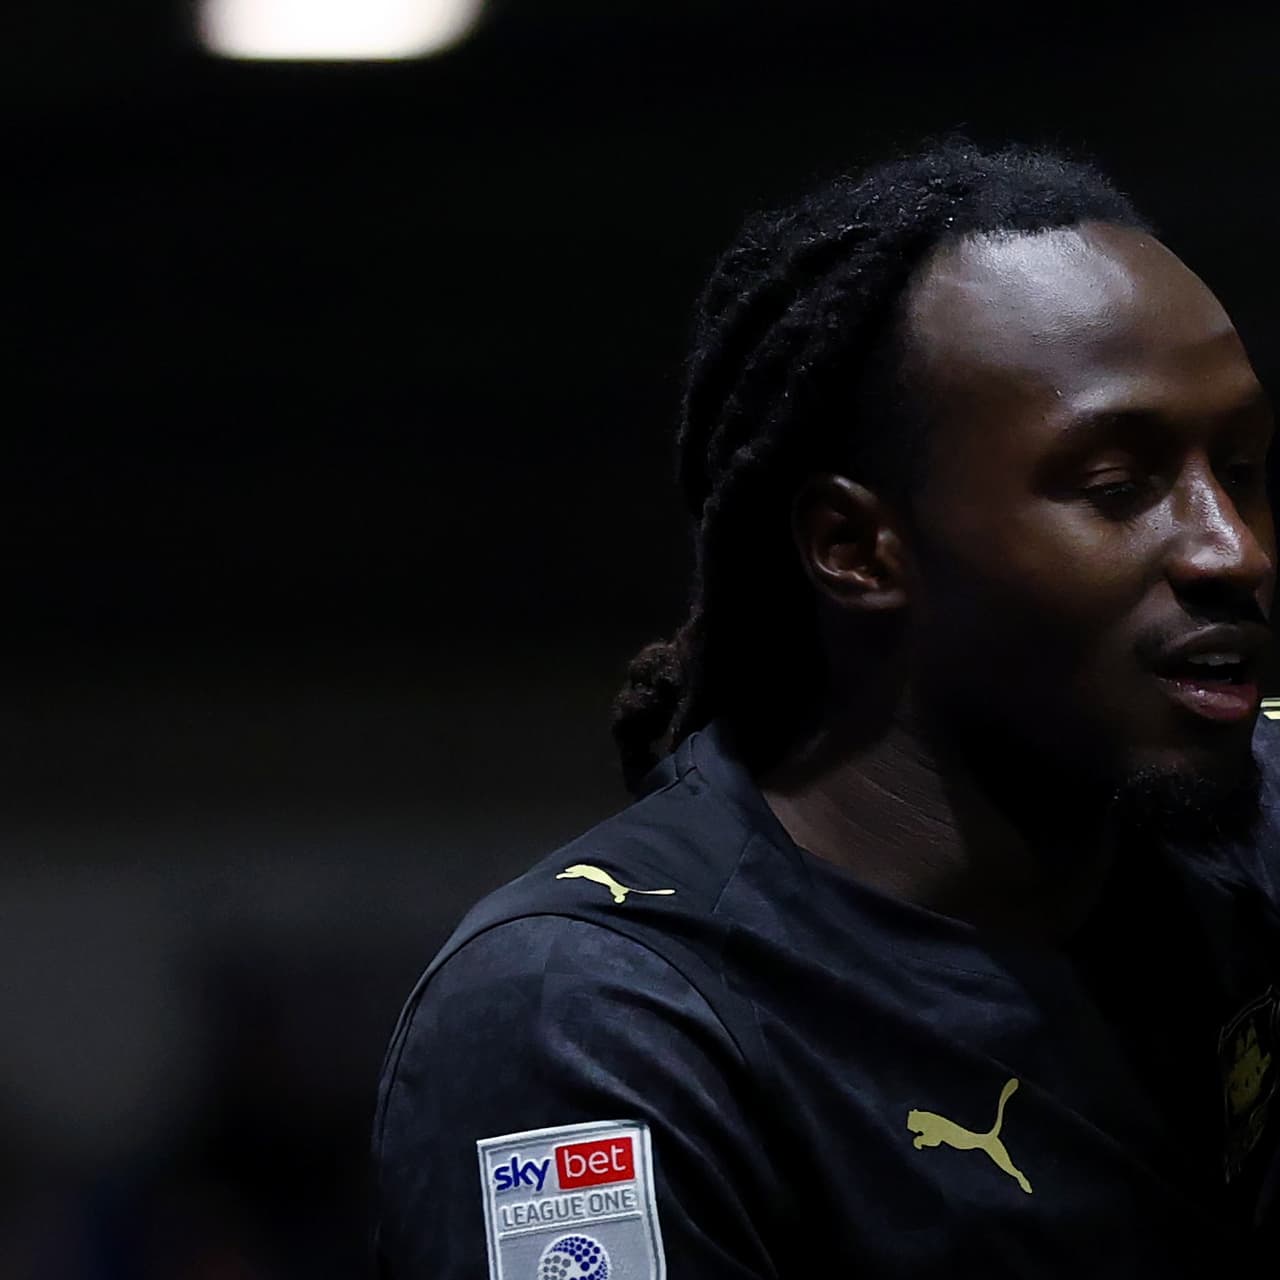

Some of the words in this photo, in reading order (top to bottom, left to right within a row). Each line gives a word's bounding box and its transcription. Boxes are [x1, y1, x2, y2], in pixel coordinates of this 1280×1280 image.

[494, 1156, 550, 1191] sky
[564, 1145, 626, 1178] bet
[502, 1196, 585, 1227] LEAGUE
[589, 1189, 634, 1214] ONE
